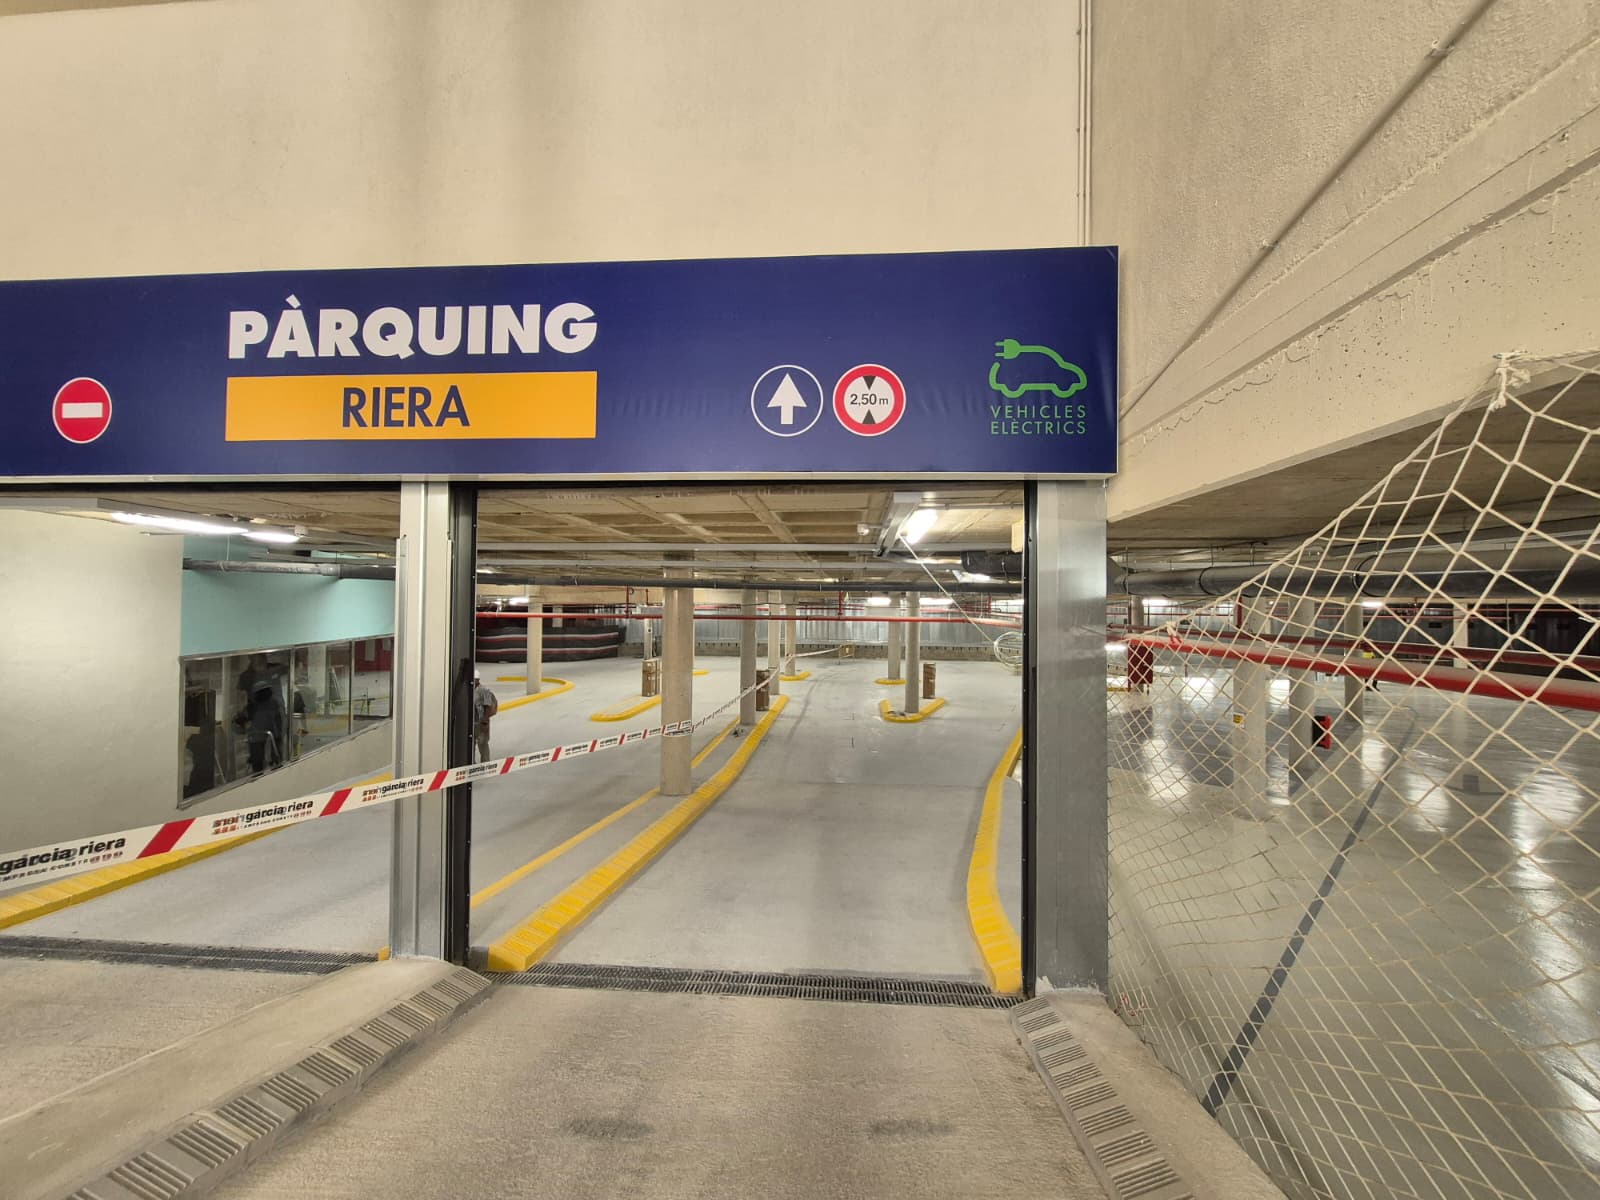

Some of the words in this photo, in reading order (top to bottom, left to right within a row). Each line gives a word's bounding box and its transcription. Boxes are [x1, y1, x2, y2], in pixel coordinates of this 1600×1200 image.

[228, 294, 598, 360] PÀRQUING
[341, 385, 471, 429] RIERA
[850, 393, 877, 407] 2,50
[990, 405, 1086, 419] VEHICLES
[991, 418, 1086, 435] ELÈCTRICS
[287, 801, 314, 813] riera
[78, 837, 126, 855] riera
